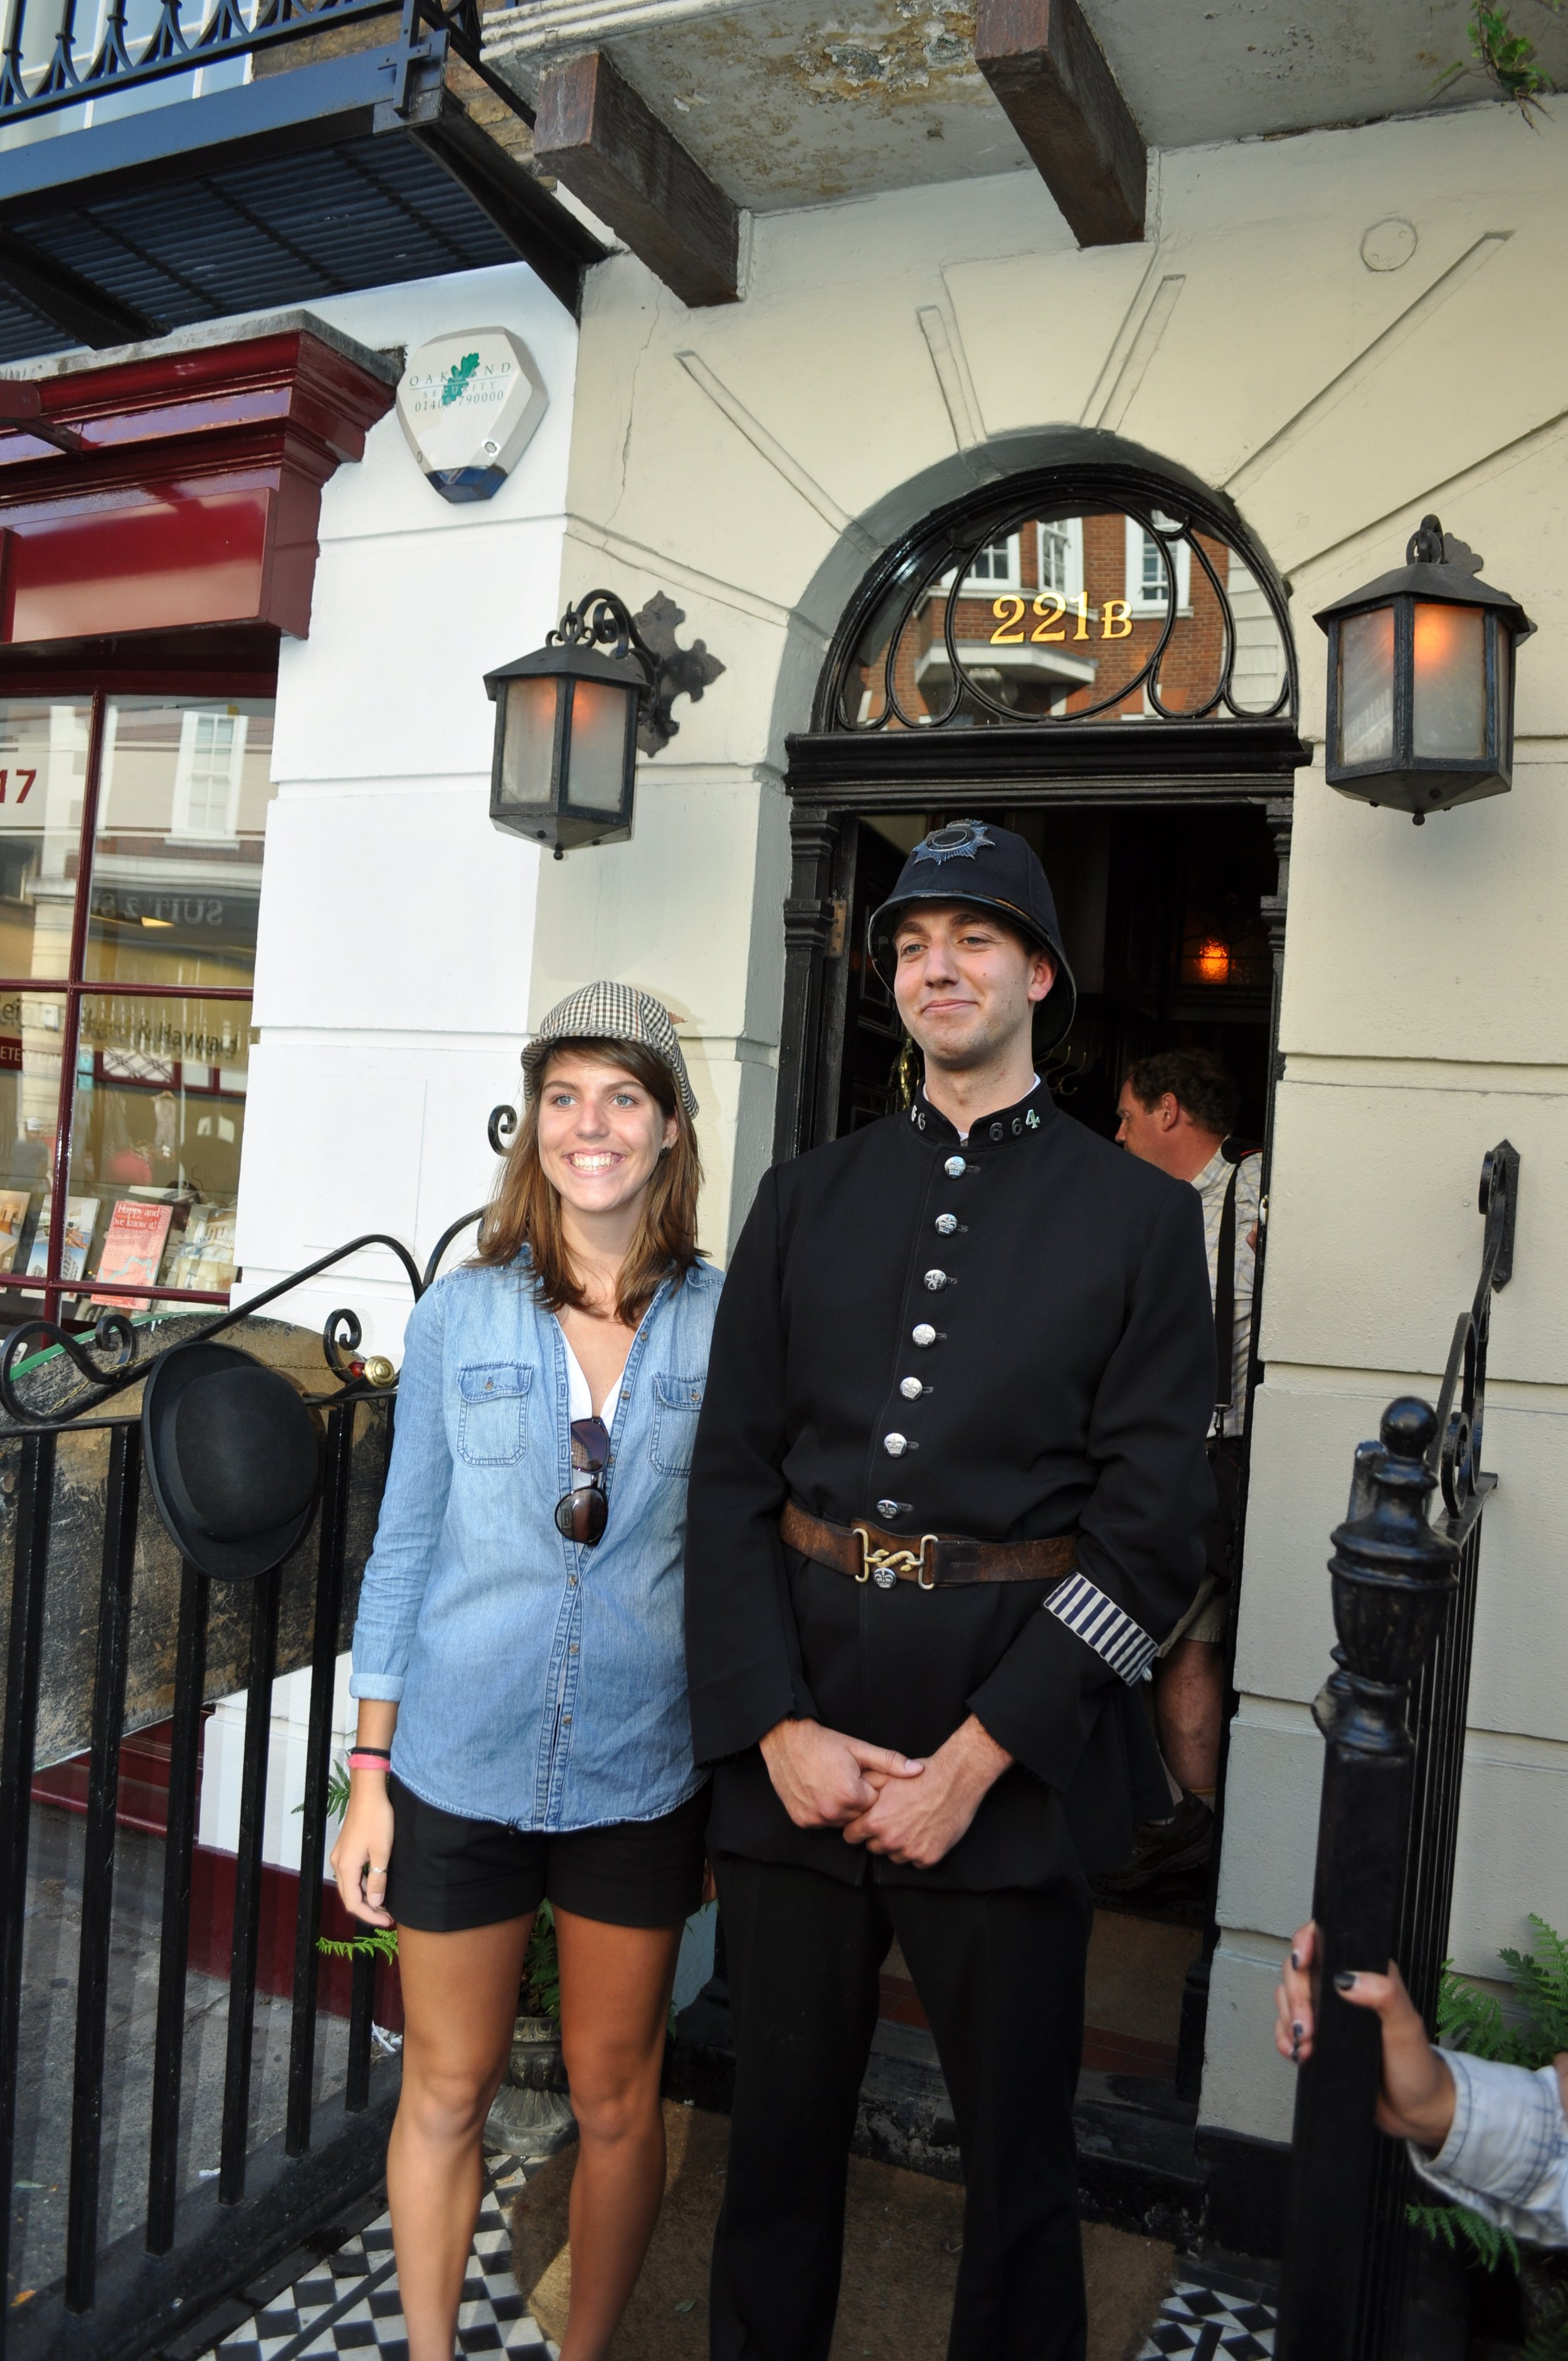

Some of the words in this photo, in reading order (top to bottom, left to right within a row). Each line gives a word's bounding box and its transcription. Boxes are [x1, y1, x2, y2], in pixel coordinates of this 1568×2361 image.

[410, 362, 511, 386] OAKLAND
[423, 381, 495, 398] SECURITY
[458, 390, 504, 406] 790000
[990, 591, 1133, 645] 221B
[989, 1109, 1041, 1142] 664
[117, 1204, 142, 1218] Happy
[144, 1207, 160, 1217] and
[114, 1218, 125, 1226] we
[126, 1216, 146, 1228] know
[147, 1219, 157, 1229] it!
